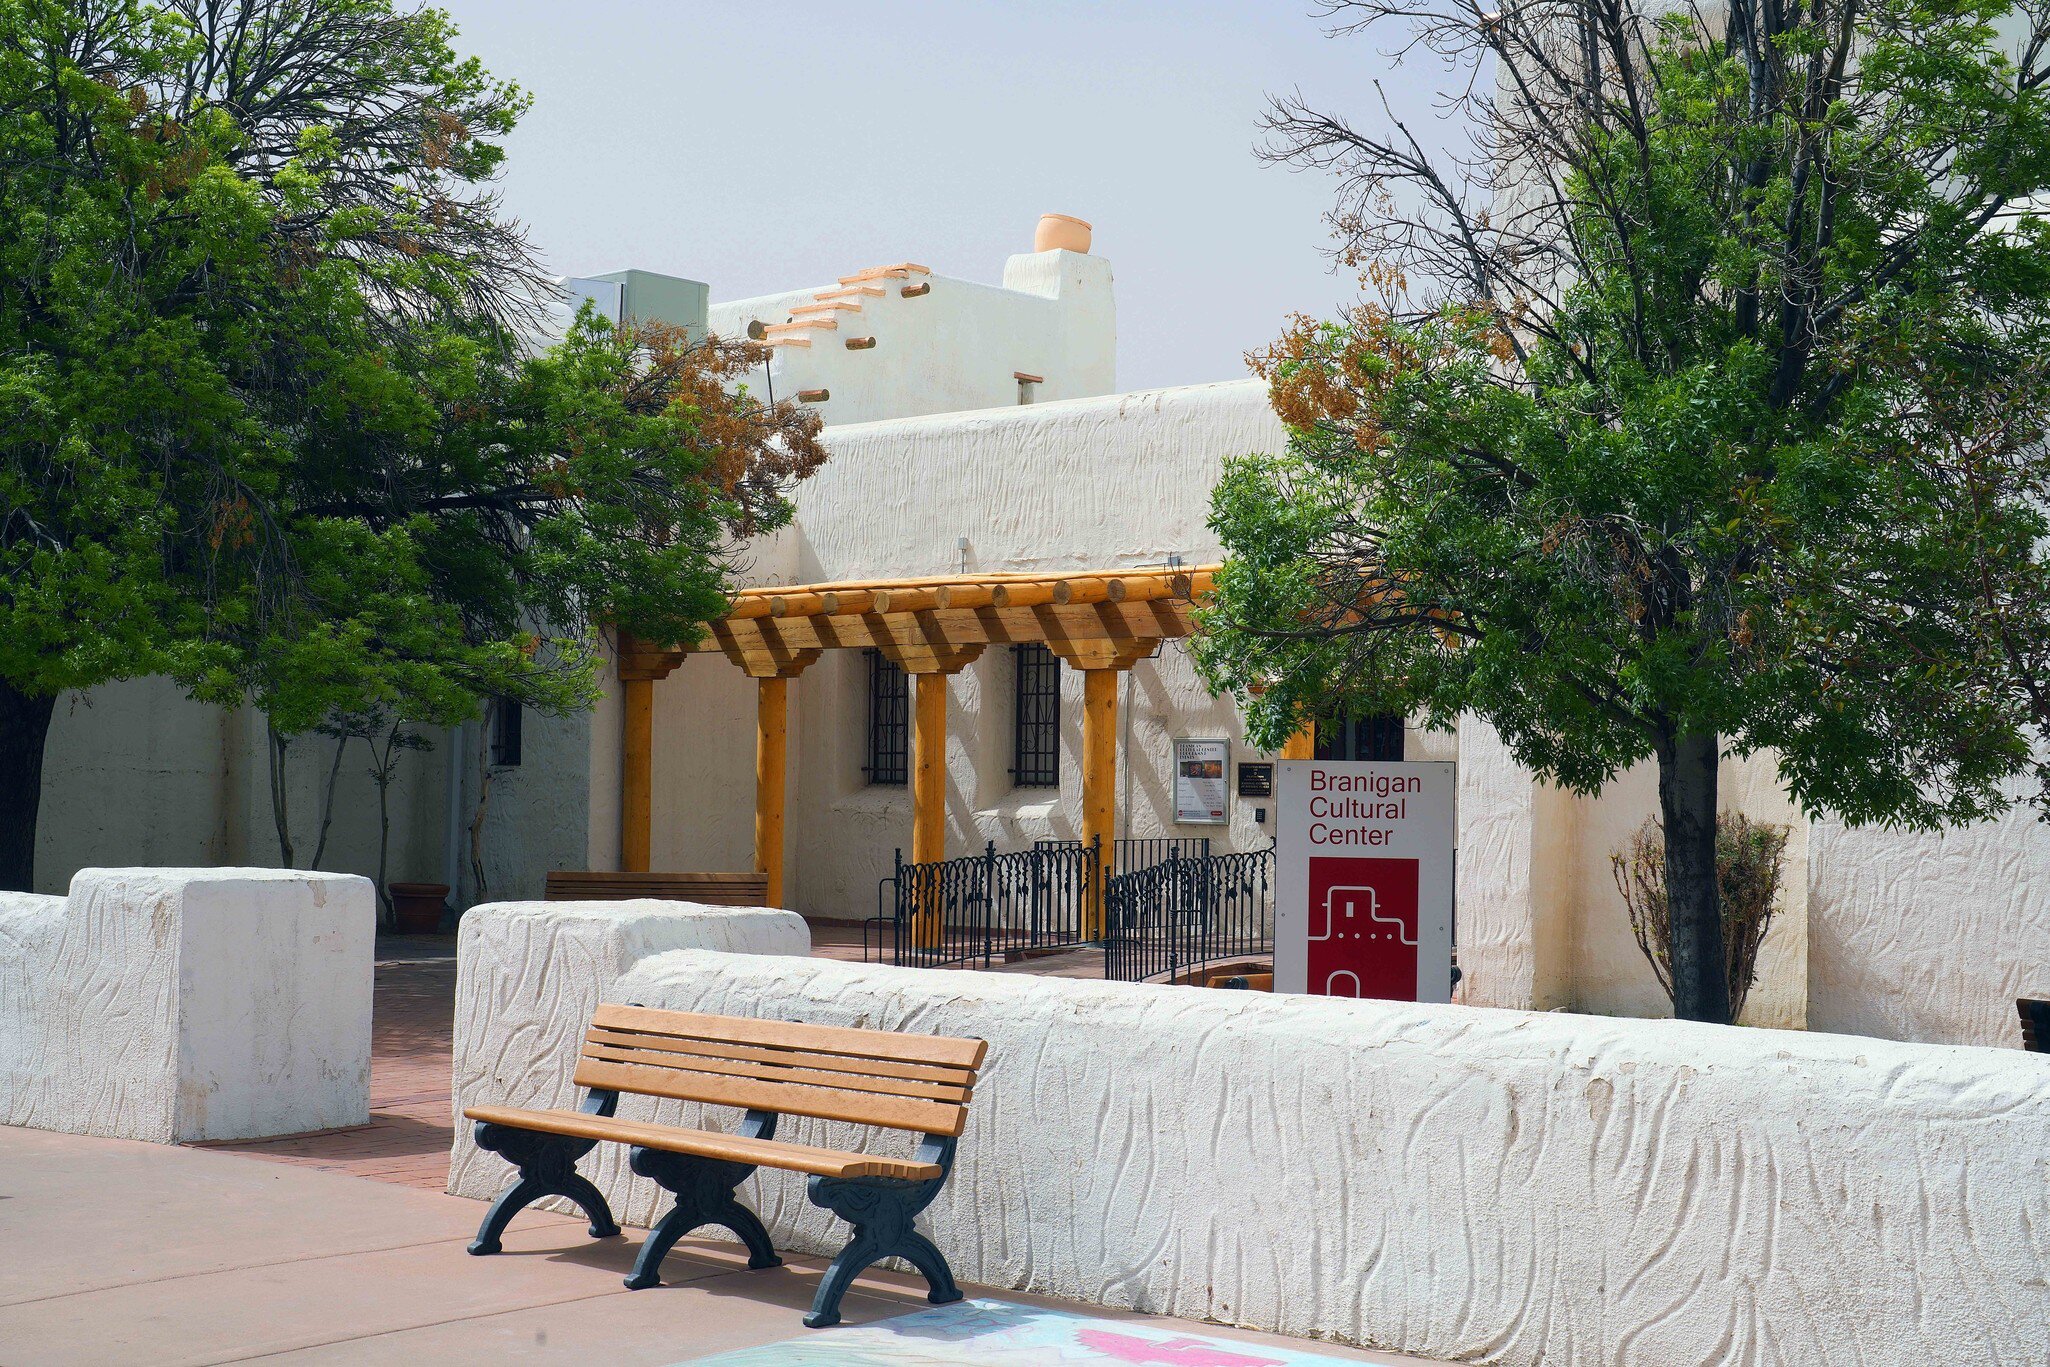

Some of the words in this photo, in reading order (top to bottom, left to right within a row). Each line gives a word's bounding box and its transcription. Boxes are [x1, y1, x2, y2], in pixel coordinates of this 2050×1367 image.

[1310, 769, 1421, 798] Branigan
[1309, 796, 1405, 819] Cultural
[1309, 822, 1394, 846] Center
